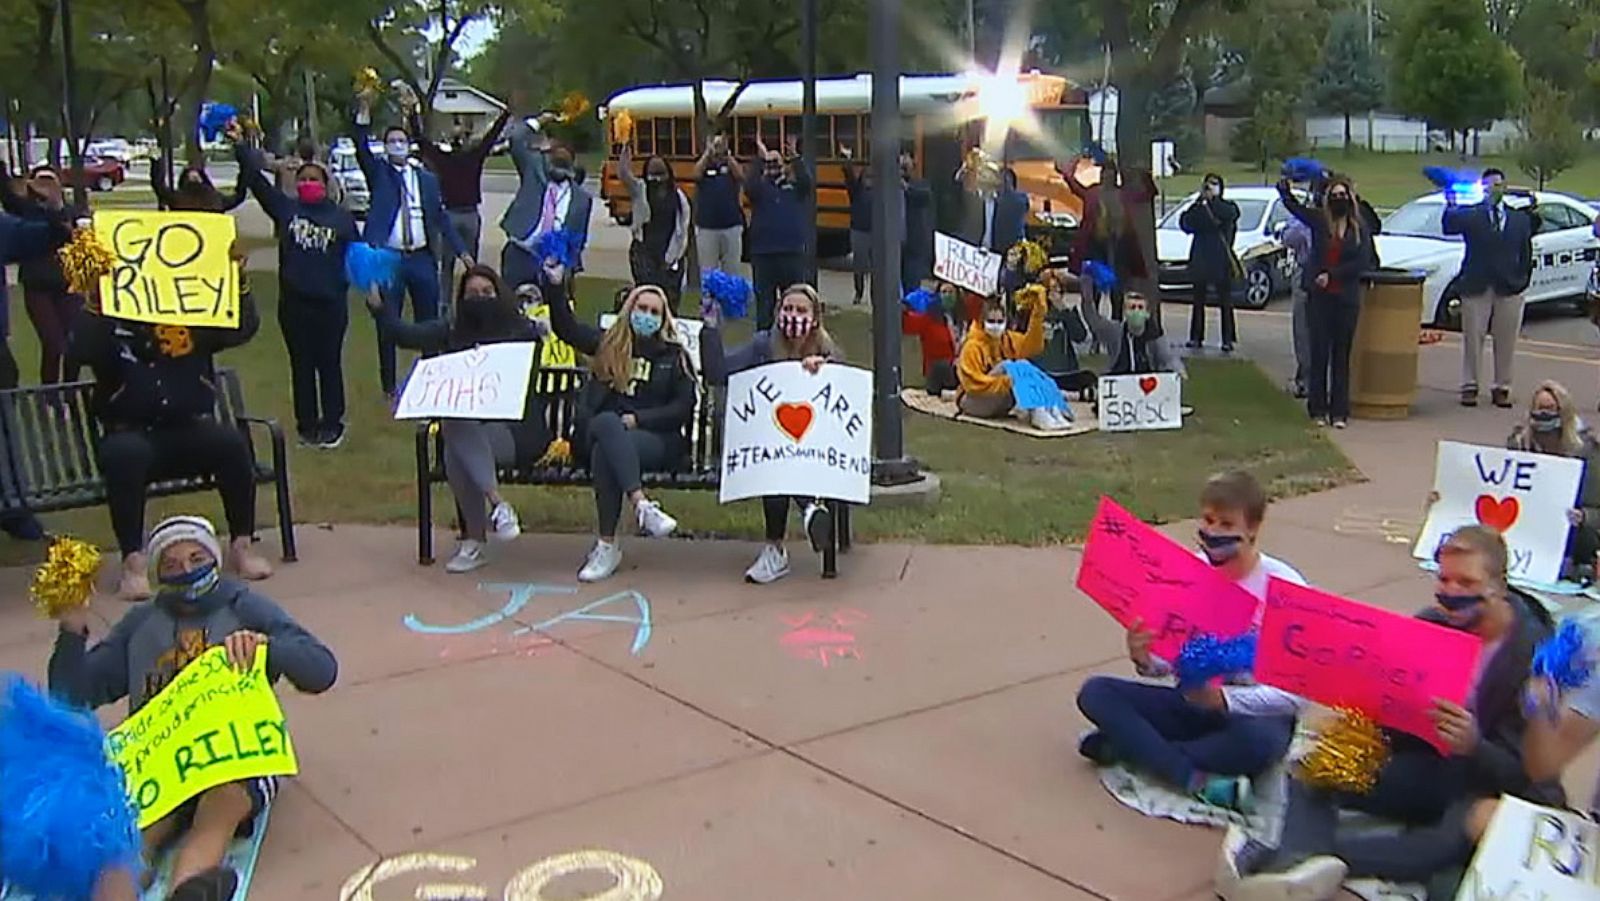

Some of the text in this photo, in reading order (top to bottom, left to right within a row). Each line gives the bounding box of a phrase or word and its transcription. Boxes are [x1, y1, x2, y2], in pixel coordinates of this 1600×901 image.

[112, 219, 204, 270] GO
[1531, 248, 1585, 271] OLICE
[112, 265, 234, 319] RILEY!
[732, 375, 864, 438] WE ARE
[1103, 379, 1118, 399] I
[1474, 452, 1537, 491] WE
[173, 719, 289, 784] RILEY
